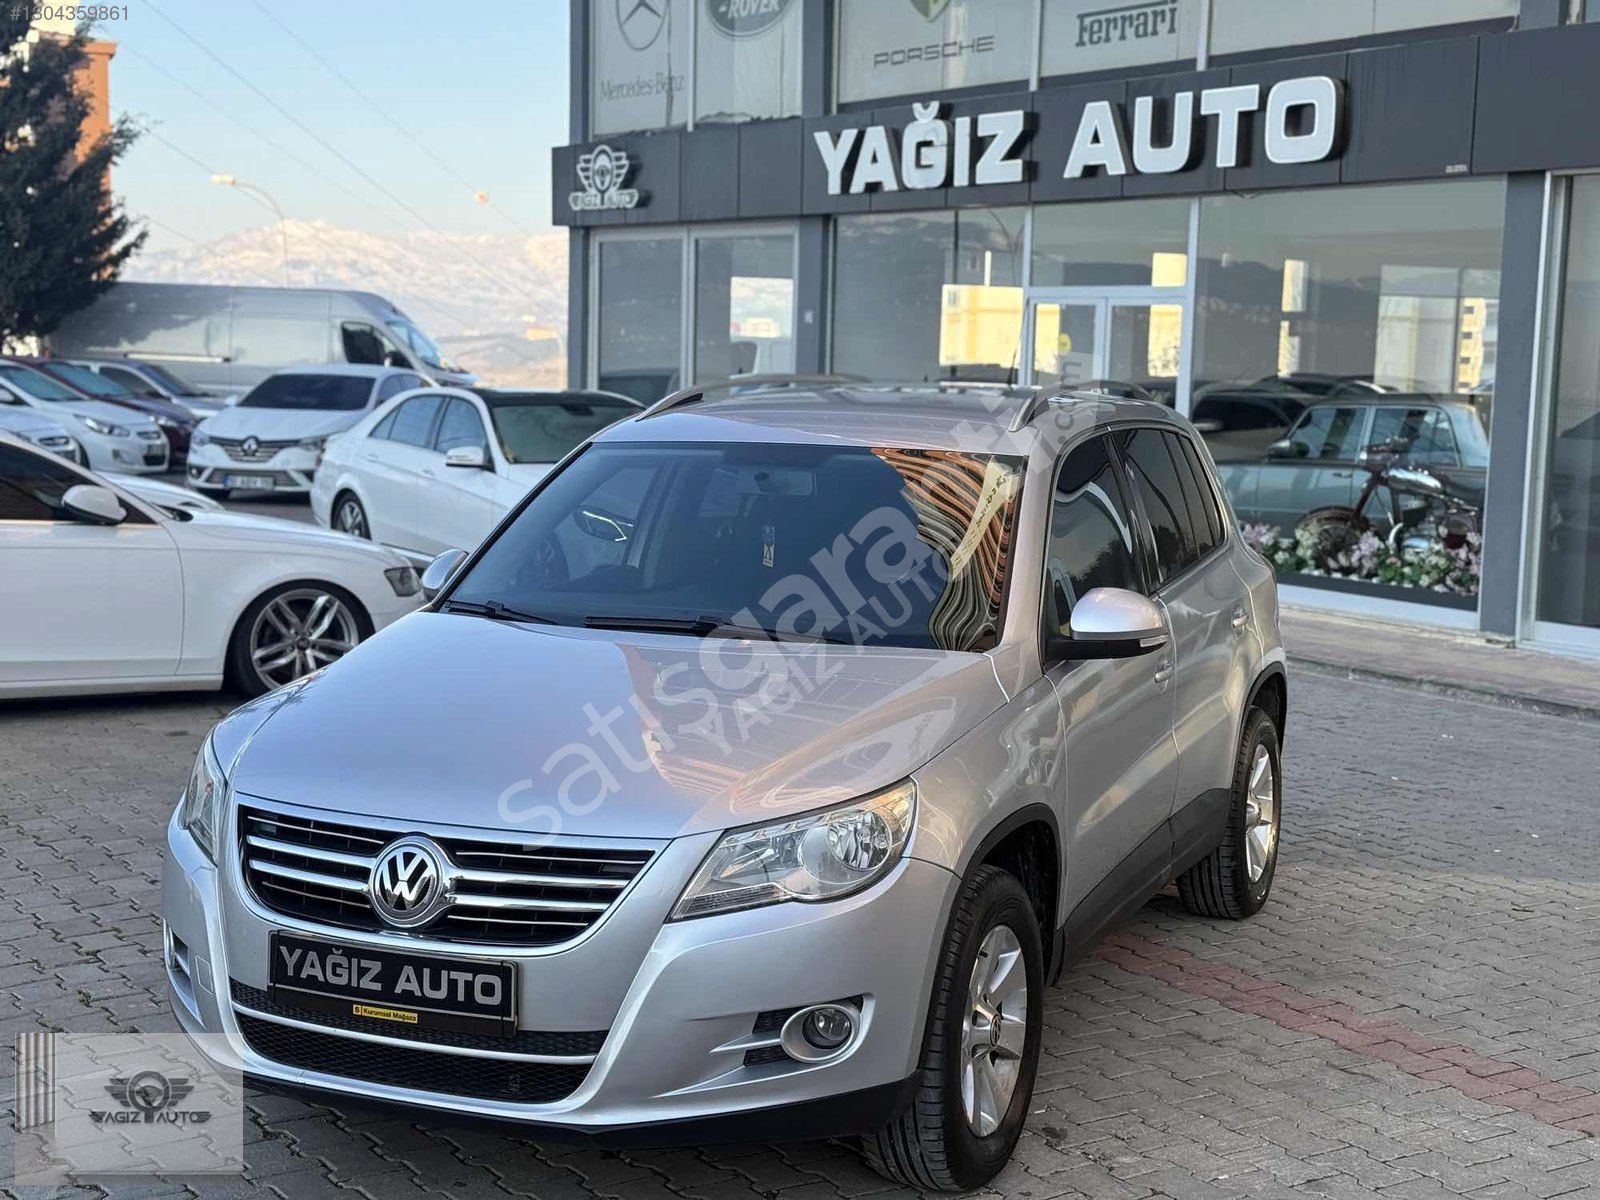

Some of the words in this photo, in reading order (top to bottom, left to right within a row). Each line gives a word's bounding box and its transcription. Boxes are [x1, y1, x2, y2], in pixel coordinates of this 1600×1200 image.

[1075, 0, 1178, 47] Ferrari
[873, 35, 995, 67] PORSCHE
[814, 101, 1027, 196] YAĞIZ
[1063, 75, 1339, 180] AUTO
[279, 945, 383, 992] YAĞIZ
[393, 965, 503, 1006] AUTO
